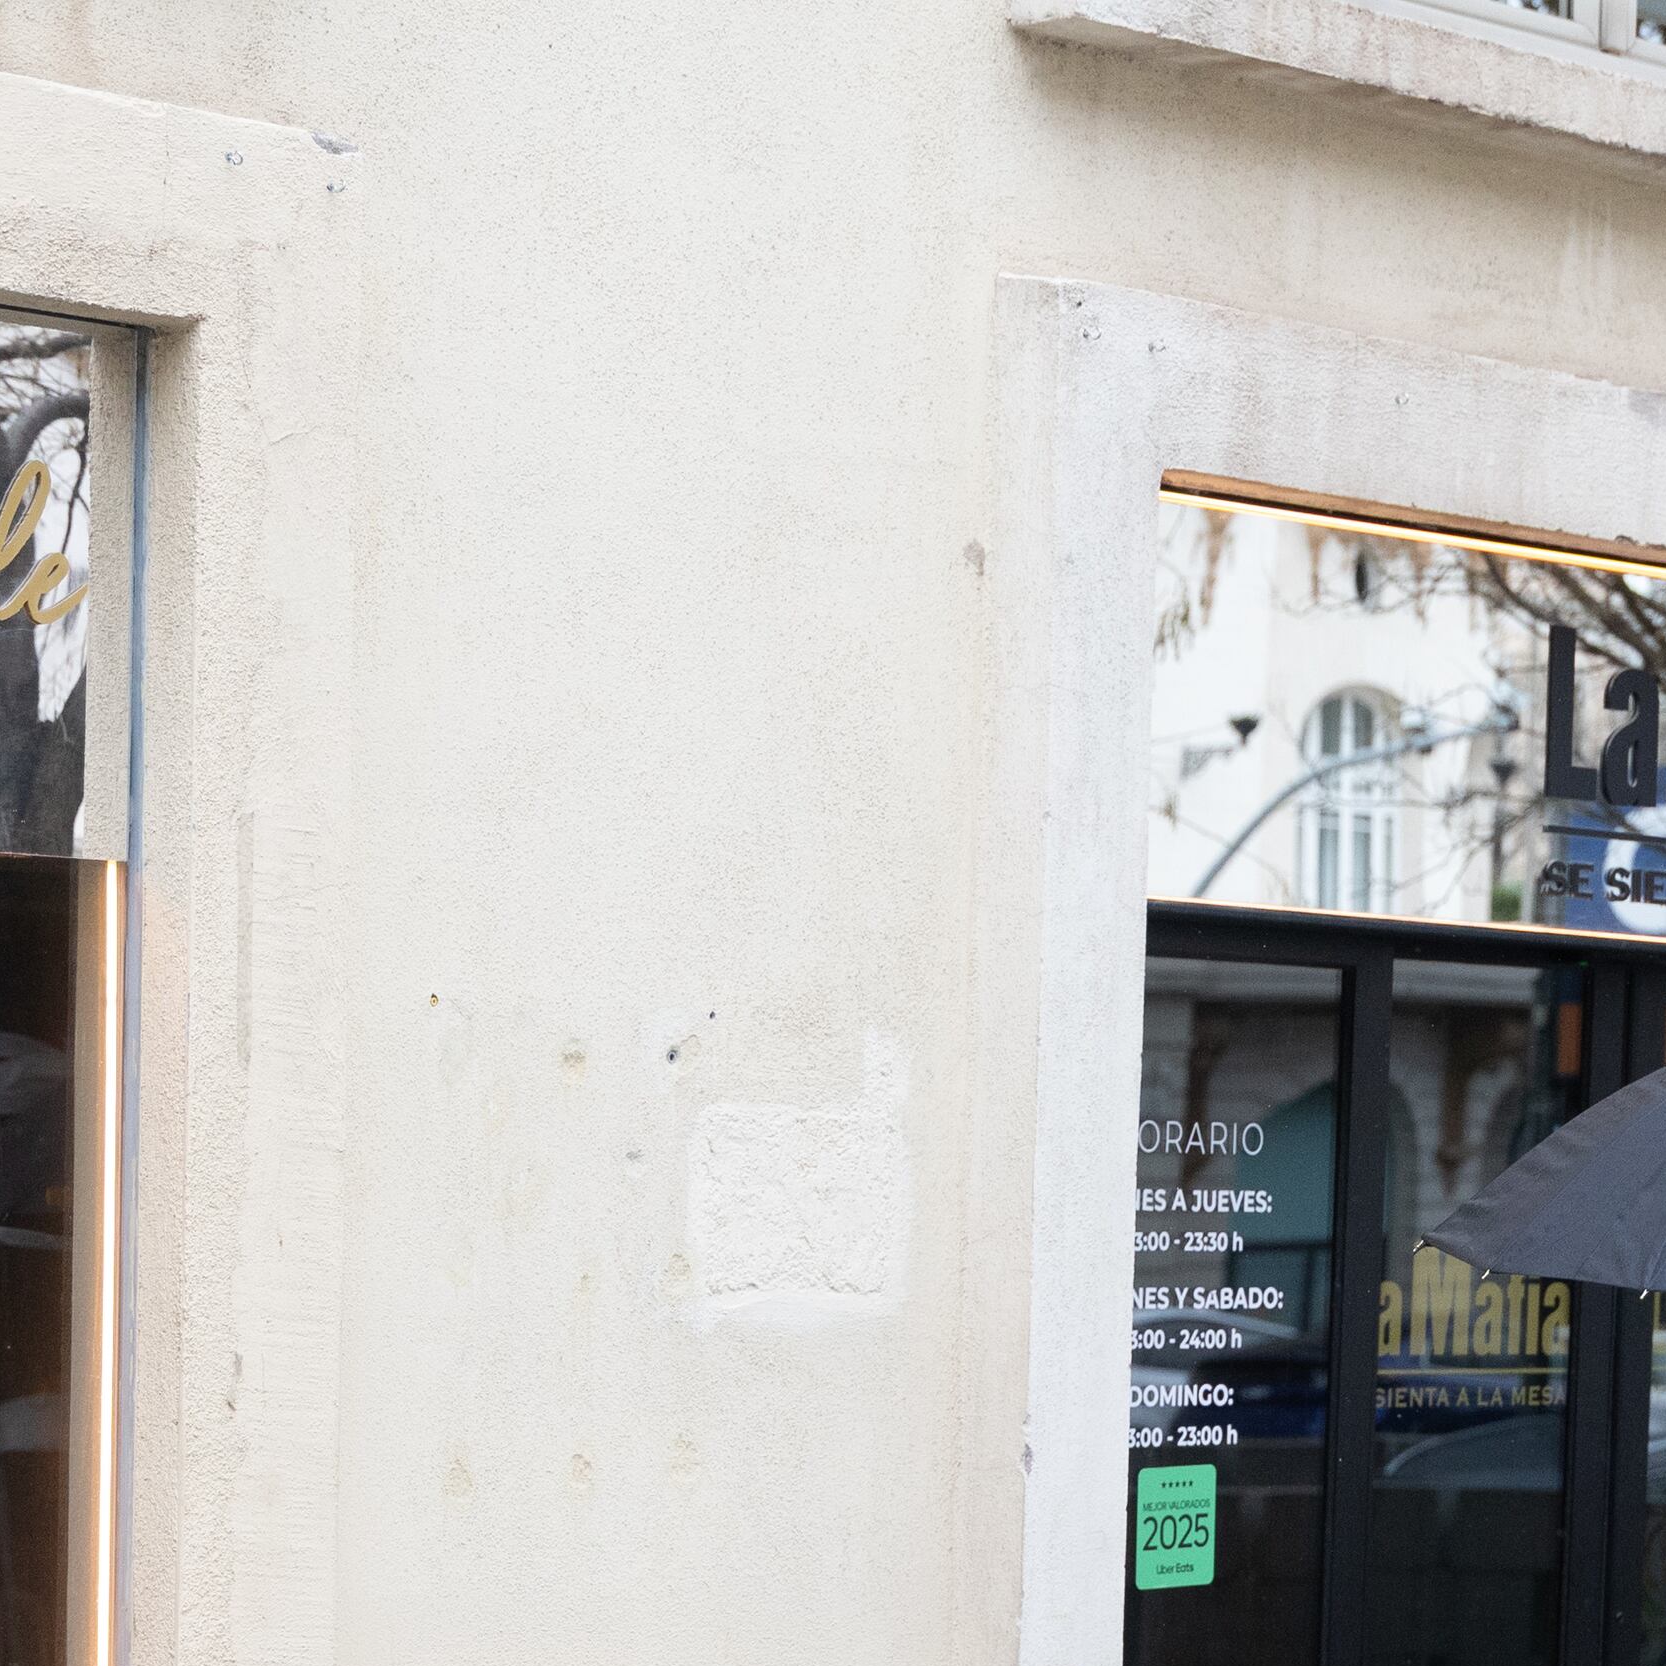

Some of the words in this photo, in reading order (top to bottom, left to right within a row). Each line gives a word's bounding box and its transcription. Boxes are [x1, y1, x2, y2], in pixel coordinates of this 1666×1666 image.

[1540, 860, 1594, 898] SE
[1138, 1119, 1264, 1156] ORARIO
[1171, 1188, 1187, 1212] A
[1191, 1189, 1273, 1213] JUEVES:
[1184, 1231, 1229, 1252] 23:30
[1232, 1230, 1244, 1252] h
[1175, 1287, 1189, 1310] Y
[1179, 1329, 1226, 1350] 24:00
[1231, 1328, 1243, 1349] h
[1130, 1383, 1235, 1408] DOMINGO:
[1376, 1387, 1450, 1408] SIENTA
[1455, 1386, 1470, 1408] A
[1476, 1386, 1503, 1408] LA
[1510, 1385, 1567, 1407] MESA
[1177, 1426, 1223, 1447] 23:00
[1227, 1424, 1238, 1446] h
[1143, 1502, 1167, 1511] MEJOR
[1143, 1513, 1210, 1551] 2025
[1156, 1563, 1174, 1574] Uber
[1175, 1562, 1194, 1573] Eats
